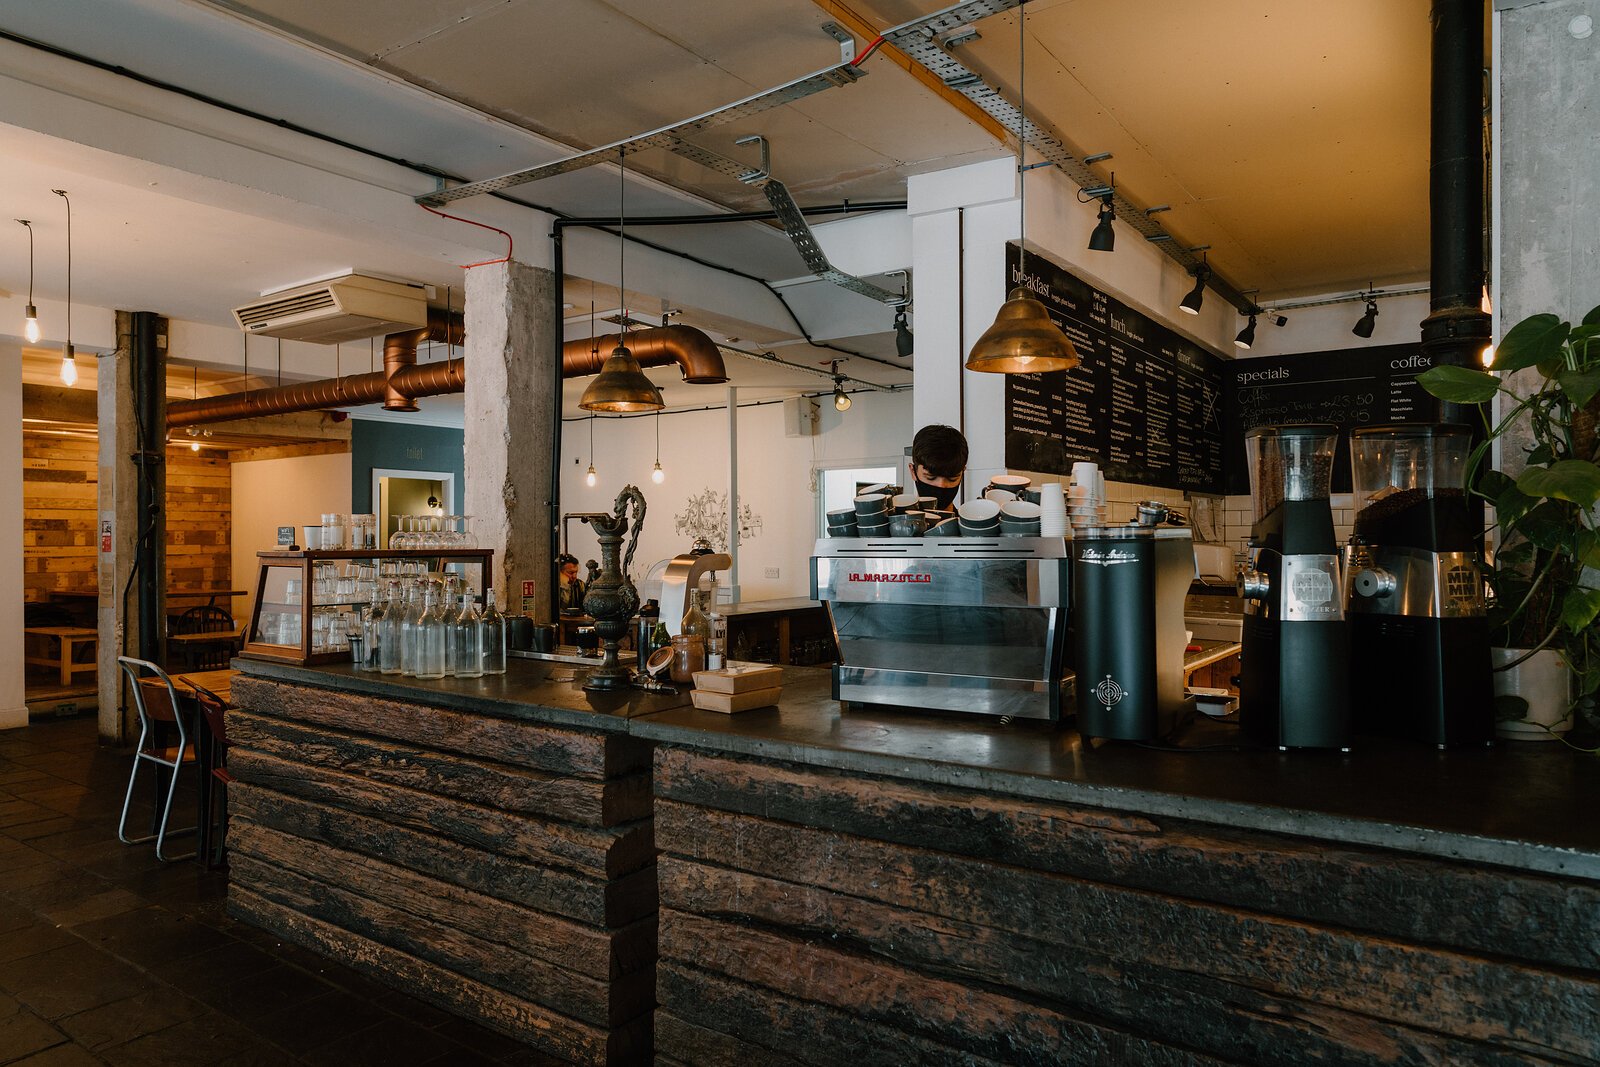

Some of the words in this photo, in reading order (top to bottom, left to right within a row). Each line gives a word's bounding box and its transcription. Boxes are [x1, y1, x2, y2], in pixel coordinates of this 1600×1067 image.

[1012, 263, 1050, 298] breakfast
[1110, 312, 1126, 334] lunch
[1237, 367, 1290, 385] specials
[863, 573, 932, 583] MARZOCCO
